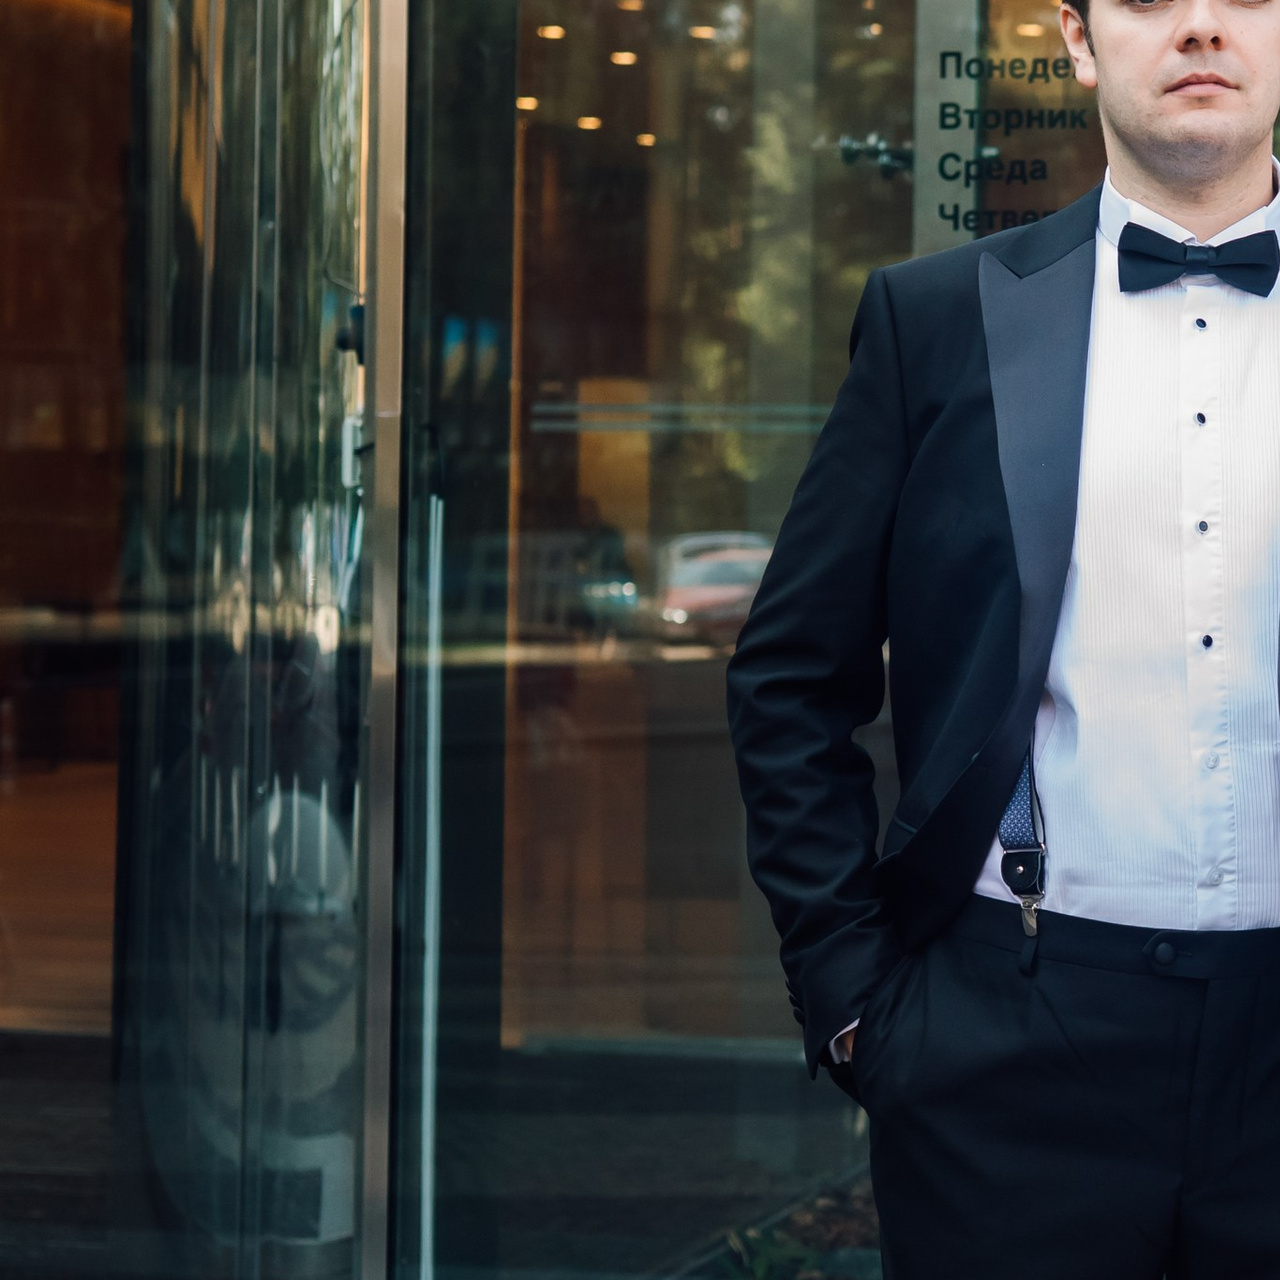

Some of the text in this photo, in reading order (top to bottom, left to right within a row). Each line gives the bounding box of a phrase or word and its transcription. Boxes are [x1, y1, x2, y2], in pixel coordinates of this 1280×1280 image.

[939, 51, 1076, 84] Понеде
[939, 103, 1088, 137] Вторник
[938, 152, 1049, 189] Среда
